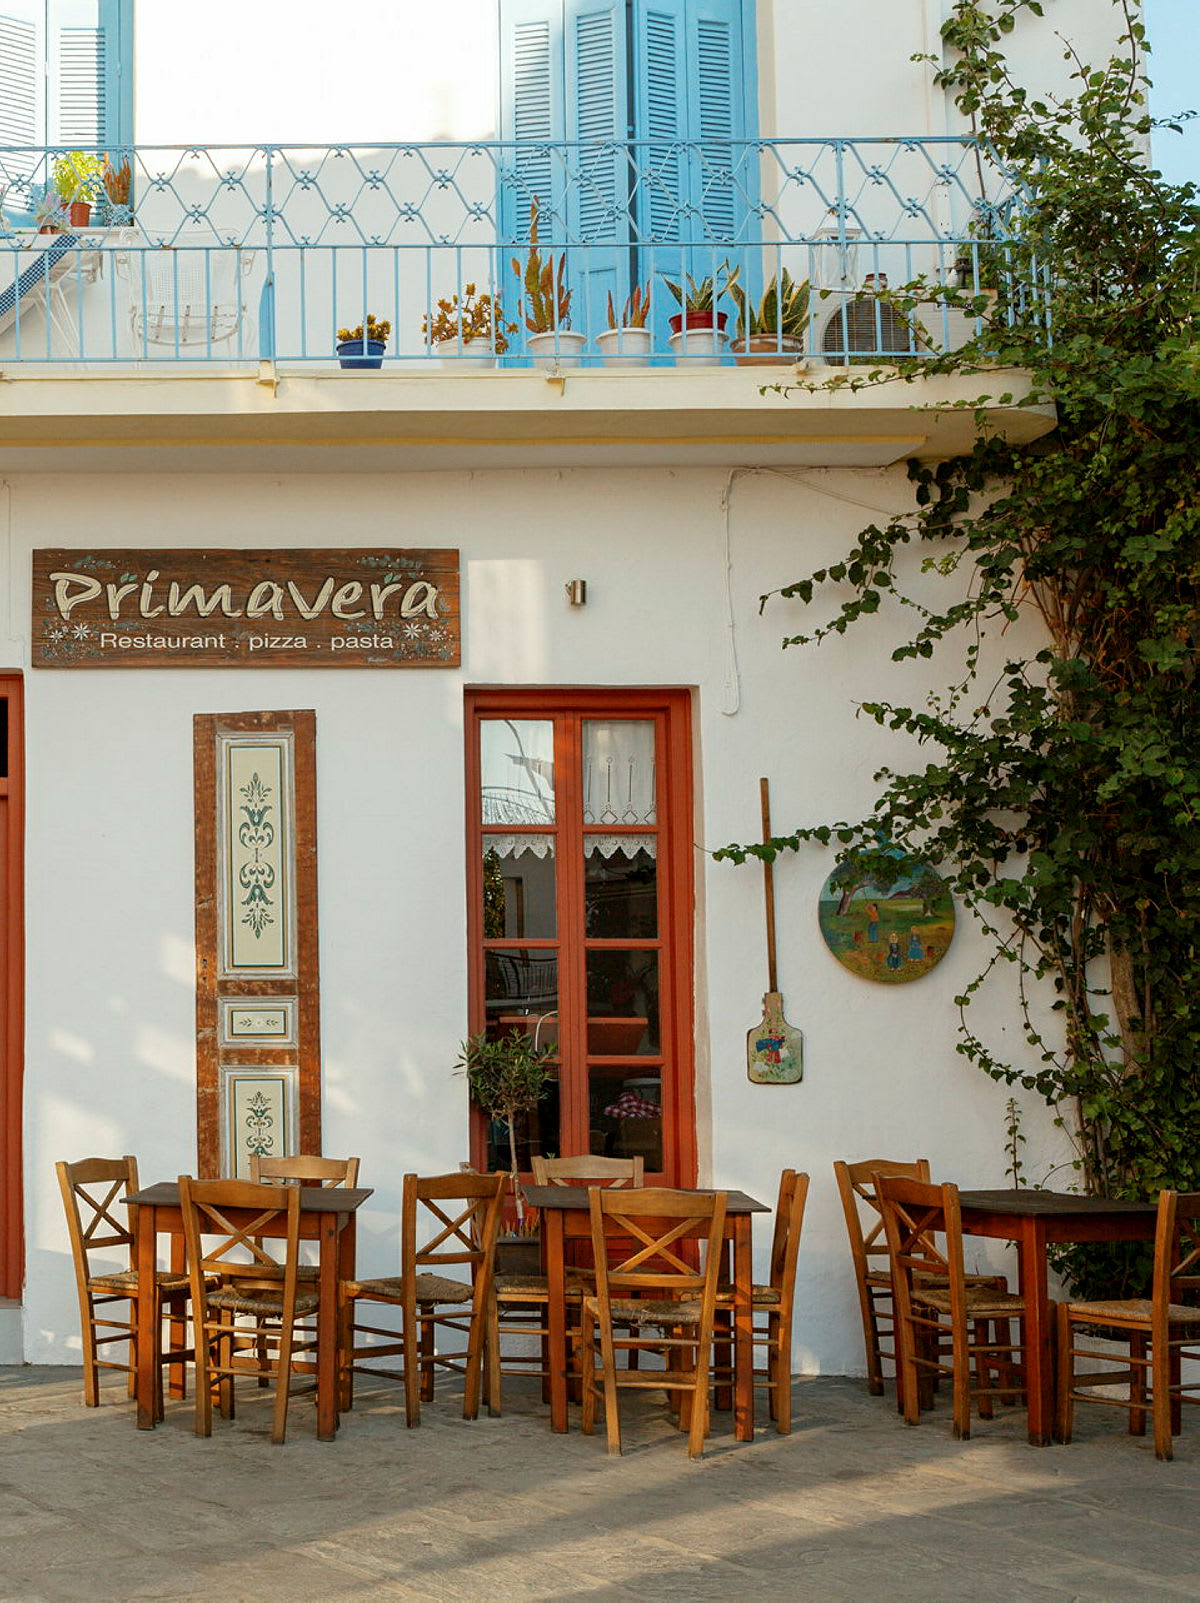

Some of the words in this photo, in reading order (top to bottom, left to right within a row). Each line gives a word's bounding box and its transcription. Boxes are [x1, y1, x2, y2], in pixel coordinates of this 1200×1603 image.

[49, 569, 440, 621] Primavera
[100, 632, 226, 649] Restaurant
[249, 633, 307, 651] pizza
[331, 634, 393, 651] pasta
